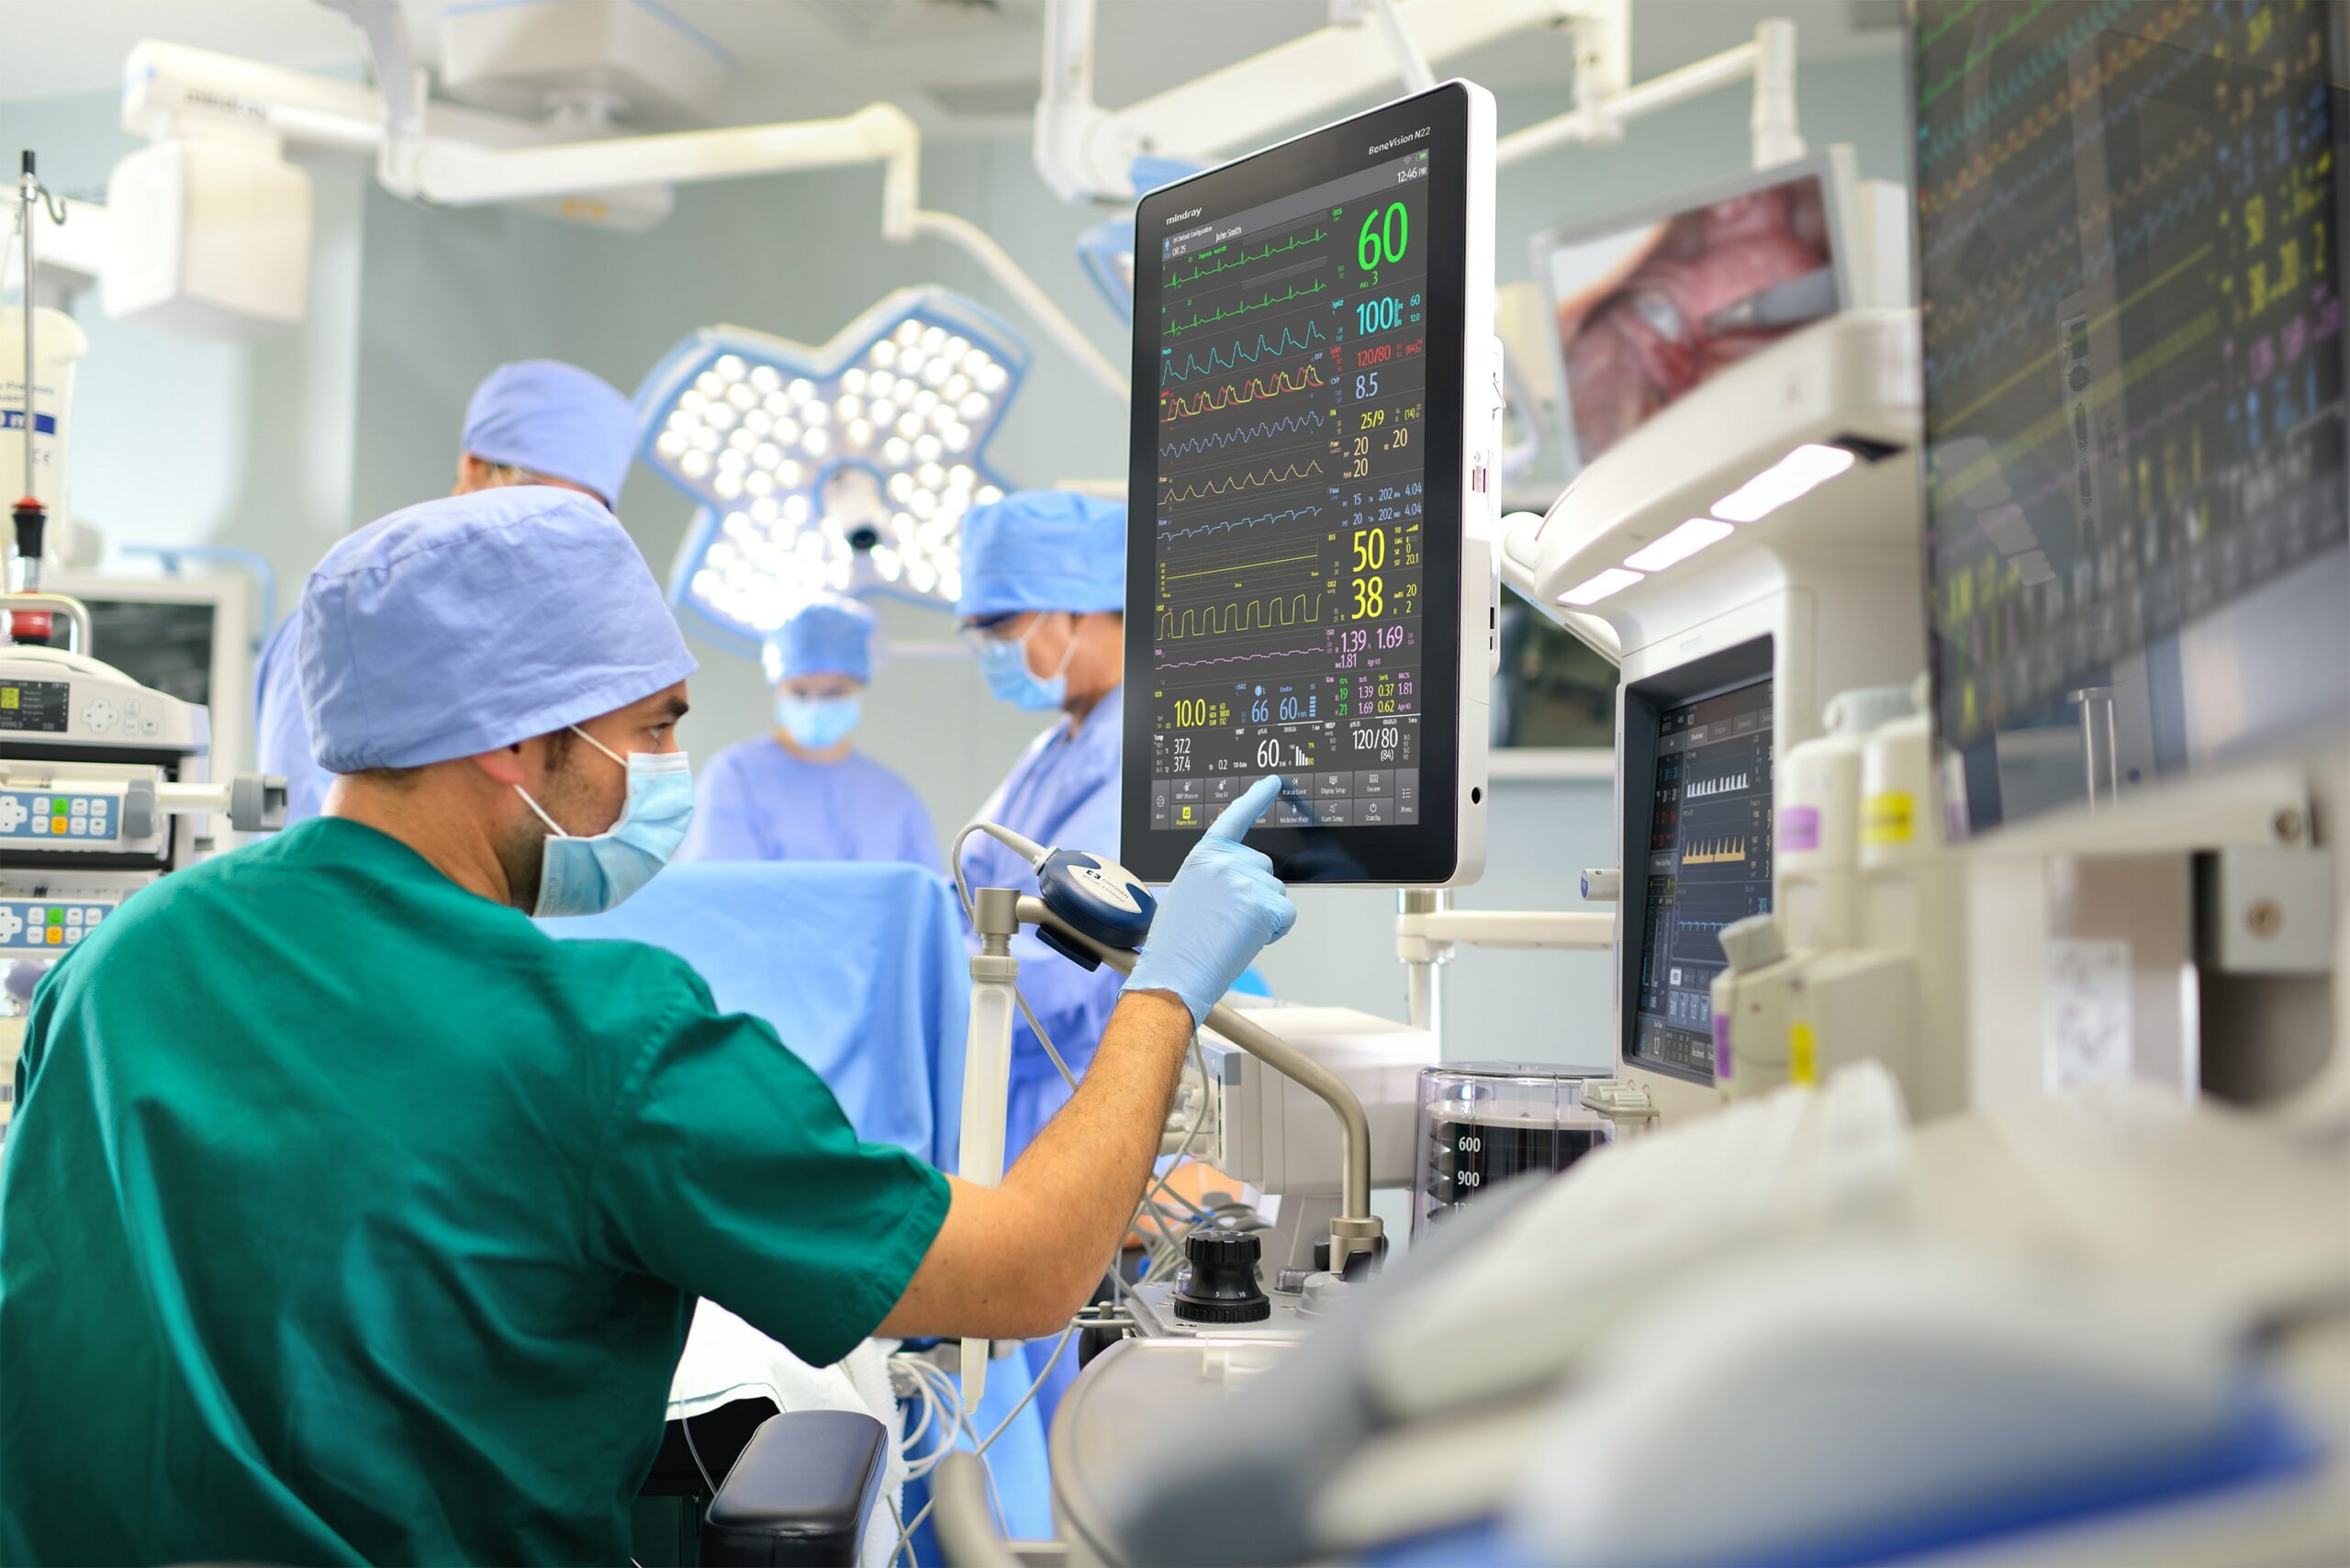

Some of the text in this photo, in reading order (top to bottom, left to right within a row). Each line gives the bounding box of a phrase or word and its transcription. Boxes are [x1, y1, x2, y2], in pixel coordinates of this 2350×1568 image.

[1369, 127, 1431, 155] BeneVision N22
[1397, 166, 1427, 183] 12:46 PM
[1166, 207, 1202, 225] mindray
[1333, 207, 1342, 217] ECG
[1215, 226, 1242, 242] John Smith
[1359, 202, 1408, 270] 60
[1372, 271, 1378, 286] 3
[1332, 299, 1344, 309] SpO2
[1410, 294, 1420, 307] 60
[1357, 297, 1393, 335] 100
[1357, 345, 1391, 367] 120/80
[1356, 372, 1378, 398] 8.5
[1360, 408, 1416, 430] 25/9 (14)
[1353, 436, 1369, 456] 20
[1393, 428, 1407, 449] 20
[1353, 457, 1369, 477] 20
[1353, 481, 1422, 506] 15 202 4.04
[1353, 512, 1362, 525] 20
[1379, 508, 1393, 521] 202
[1404, 502, 1422, 516] 4.04
[1353, 528, 1384, 572] 50
[1406, 543, 1411, 553] 0
[1406, 554, 1418, 565] 20.1
[1352, 577, 1382, 619] 38
[1406, 584, 1416, 597] 20
[1406, 600, 1411, 613] 2
[1341, 630, 1367, 653] 1.39
[1377, 625, 1404, 649] 1.69
[1341, 653, 1357, 668] 1.81
[1339, 682, 1413, 700] 19 1.39 0.37 1.81
[1174, 699, 1205, 727] 10.0
[1252, 697, 1297, 722] 66 60
[1339, 700, 1394, 715] 21 1.69 0.62
[1174, 738, 1191, 755] 37.2
[1352, 727, 1398, 749] 120/80
[1258, 738, 1280, 767] 60
[1308, 757, 1315, 766] 80
[1381, 749, 1394, 762] (84)
[1174, 756, 1190, 772] 37.4
[1218, 759, 1227, 770] 0.2
[1459, 1137, 1481, 1153] 600
[1458, 1170, 1480, 1187] 900
